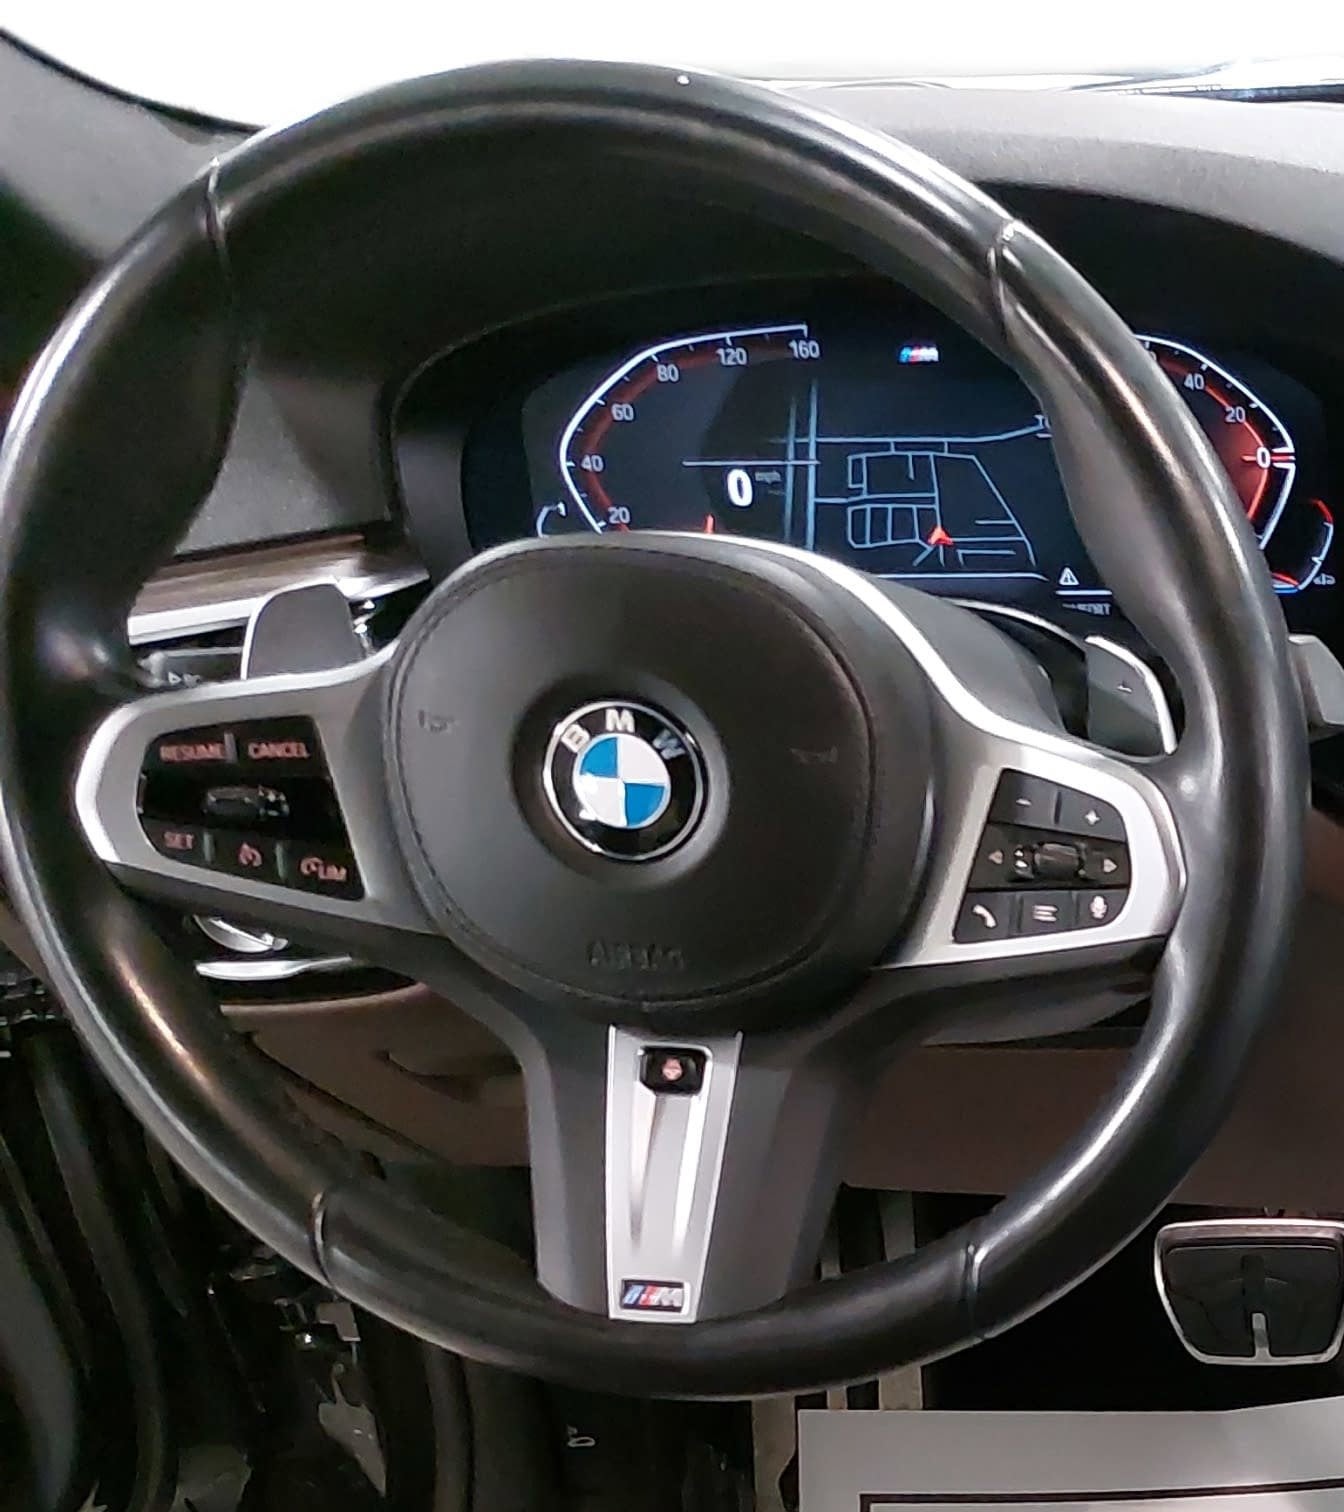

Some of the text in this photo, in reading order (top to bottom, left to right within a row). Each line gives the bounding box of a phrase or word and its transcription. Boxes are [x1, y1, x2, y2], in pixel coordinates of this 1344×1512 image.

[717, 347, 748, 367] 120
[788, 340, 820, 360] 160
[656, 363, 680, 383] 80
[1183, 373, 1205, 391] 40
[610, 402, 635, 422] 60
[1225, 406, 1247, 423] 20
[580, 453, 604, 473] 40
[1256, 447, 1271, 469] 0
[726, 468, 753, 507] 0
[607, 506, 631, 525] 20
[560, 708, 687, 760] BMW
